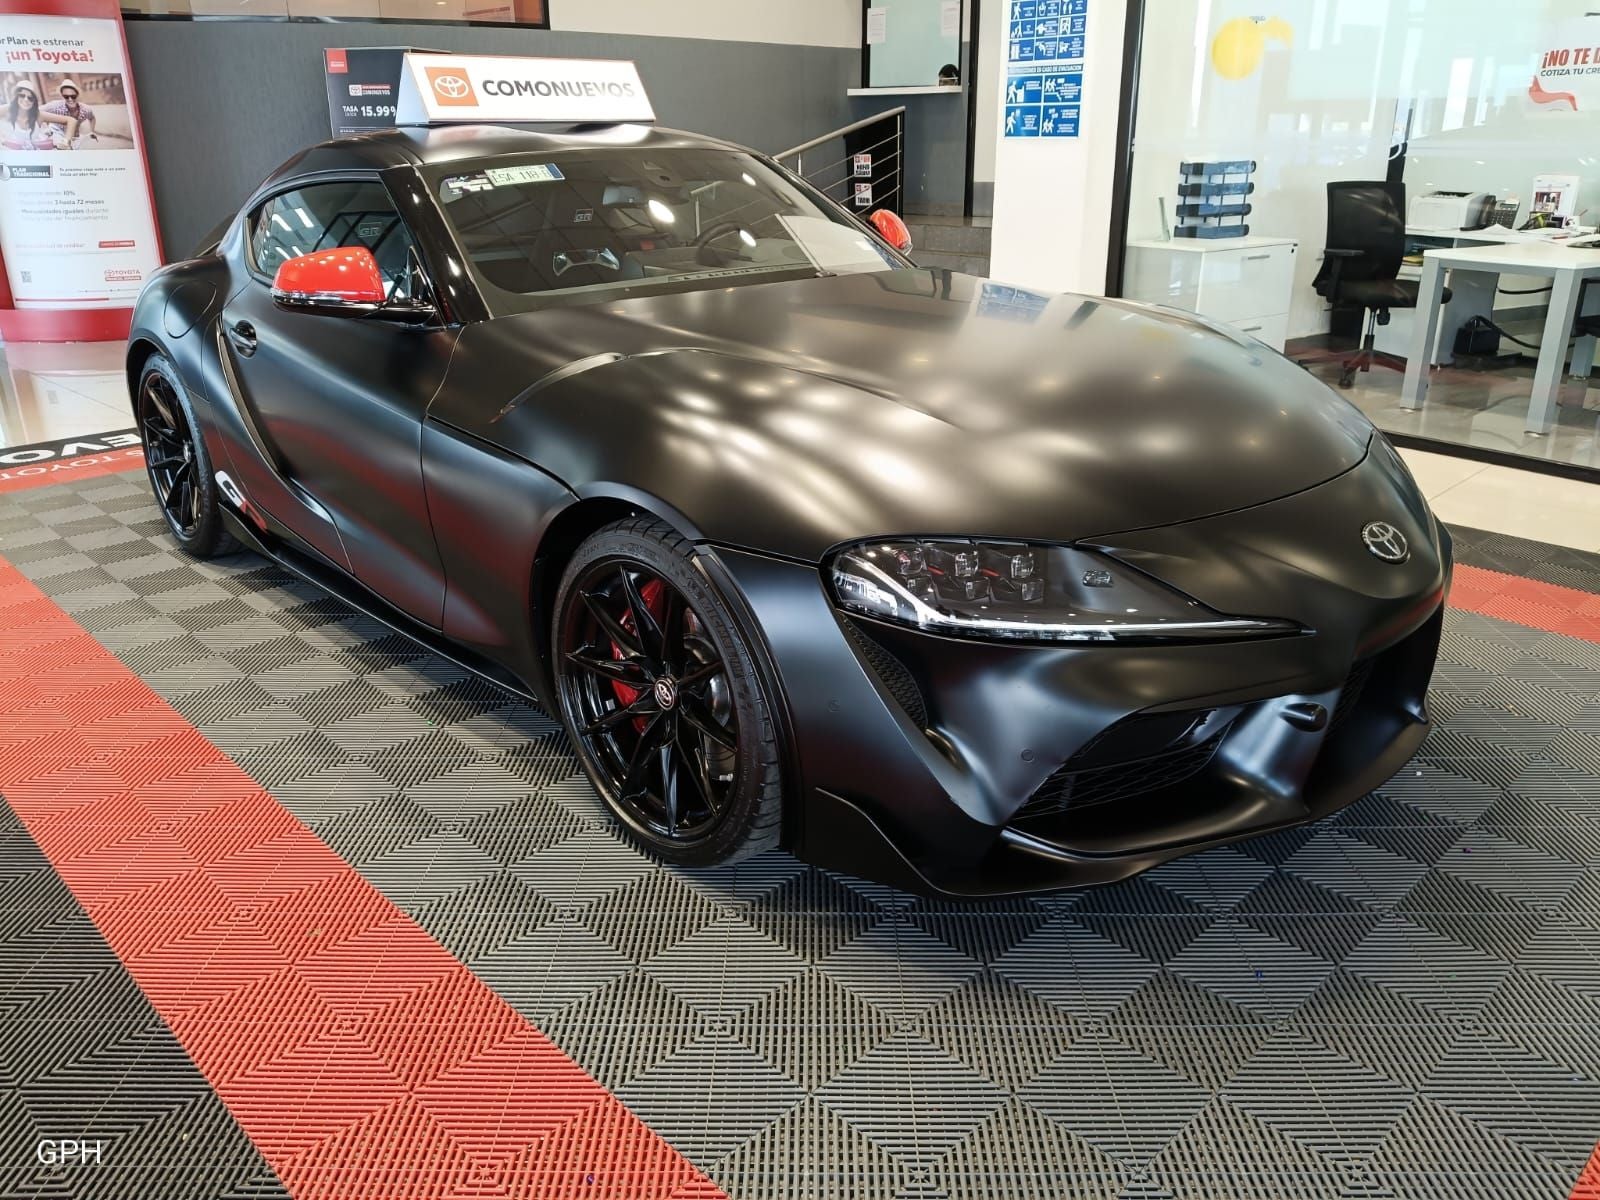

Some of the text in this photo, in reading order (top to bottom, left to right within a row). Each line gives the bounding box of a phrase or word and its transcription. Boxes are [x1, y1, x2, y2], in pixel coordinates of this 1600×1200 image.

[7, 36, 28, 45] Plan
[43, 38, 85, 47] estrenar
[5, 48, 95, 64] ¡un Toyota!
[1542, 49, 1570, 69] ¡NO
[1573, 47, 1591, 65] TE
[1540, 68, 1570, 77] COTIZA
[1573, 67, 1584, 75] TU
[482, 79, 635, 98] COMONUEVOS
[342, 105, 359, 113] TASA
